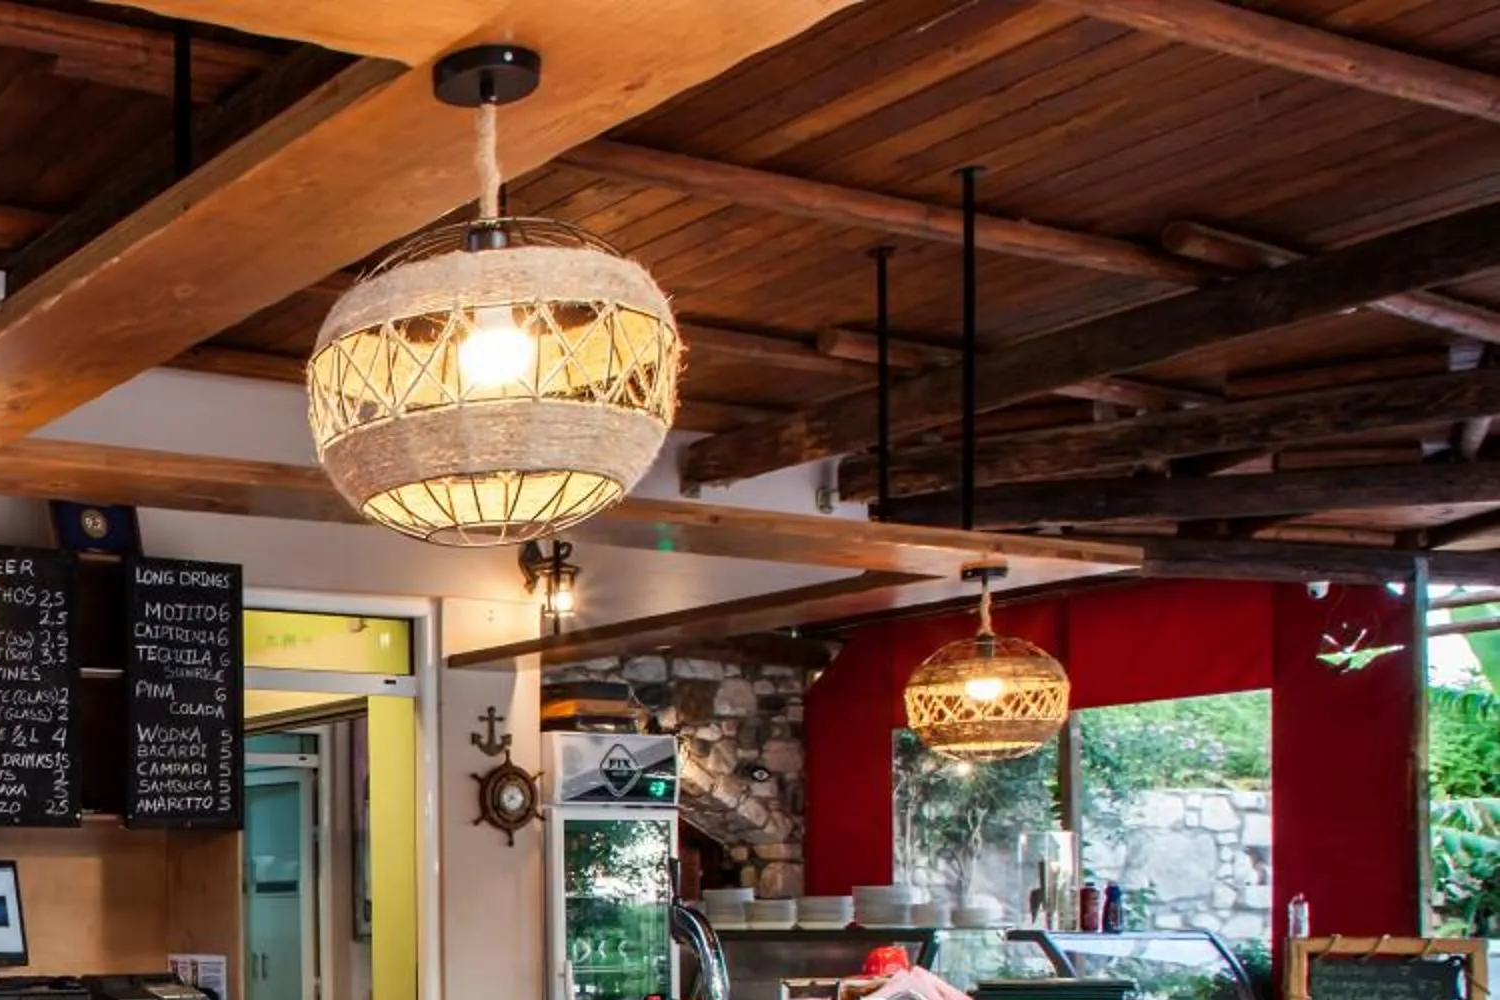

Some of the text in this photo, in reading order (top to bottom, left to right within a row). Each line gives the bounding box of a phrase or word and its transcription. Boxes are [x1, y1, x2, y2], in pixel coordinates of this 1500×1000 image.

[135, 566, 175, 586] LONG
[145, 601, 230, 622] MOJITO 6
[217, 627, 229, 647] 6
[134, 645, 213, 667] TEQUILA
[59, 687, 69, 704] 2
[135, 679, 227, 702] PINA 6
[57, 705, 69, 721] 2
[169, 701, 225, 720] COLADA
[51, 727, 67, 749] 4
[136, 722, 233, 745] WODKA 5
[137, 743, 232, 760] BACARDI 5
[136, 761, 232, 777] CAMPARI 5
[608, 757, 632, 769] FIX
[53, 769, 69, 785] 2
[219, 779, 232, 794] 5
[218, 795, 232, 811] 5
